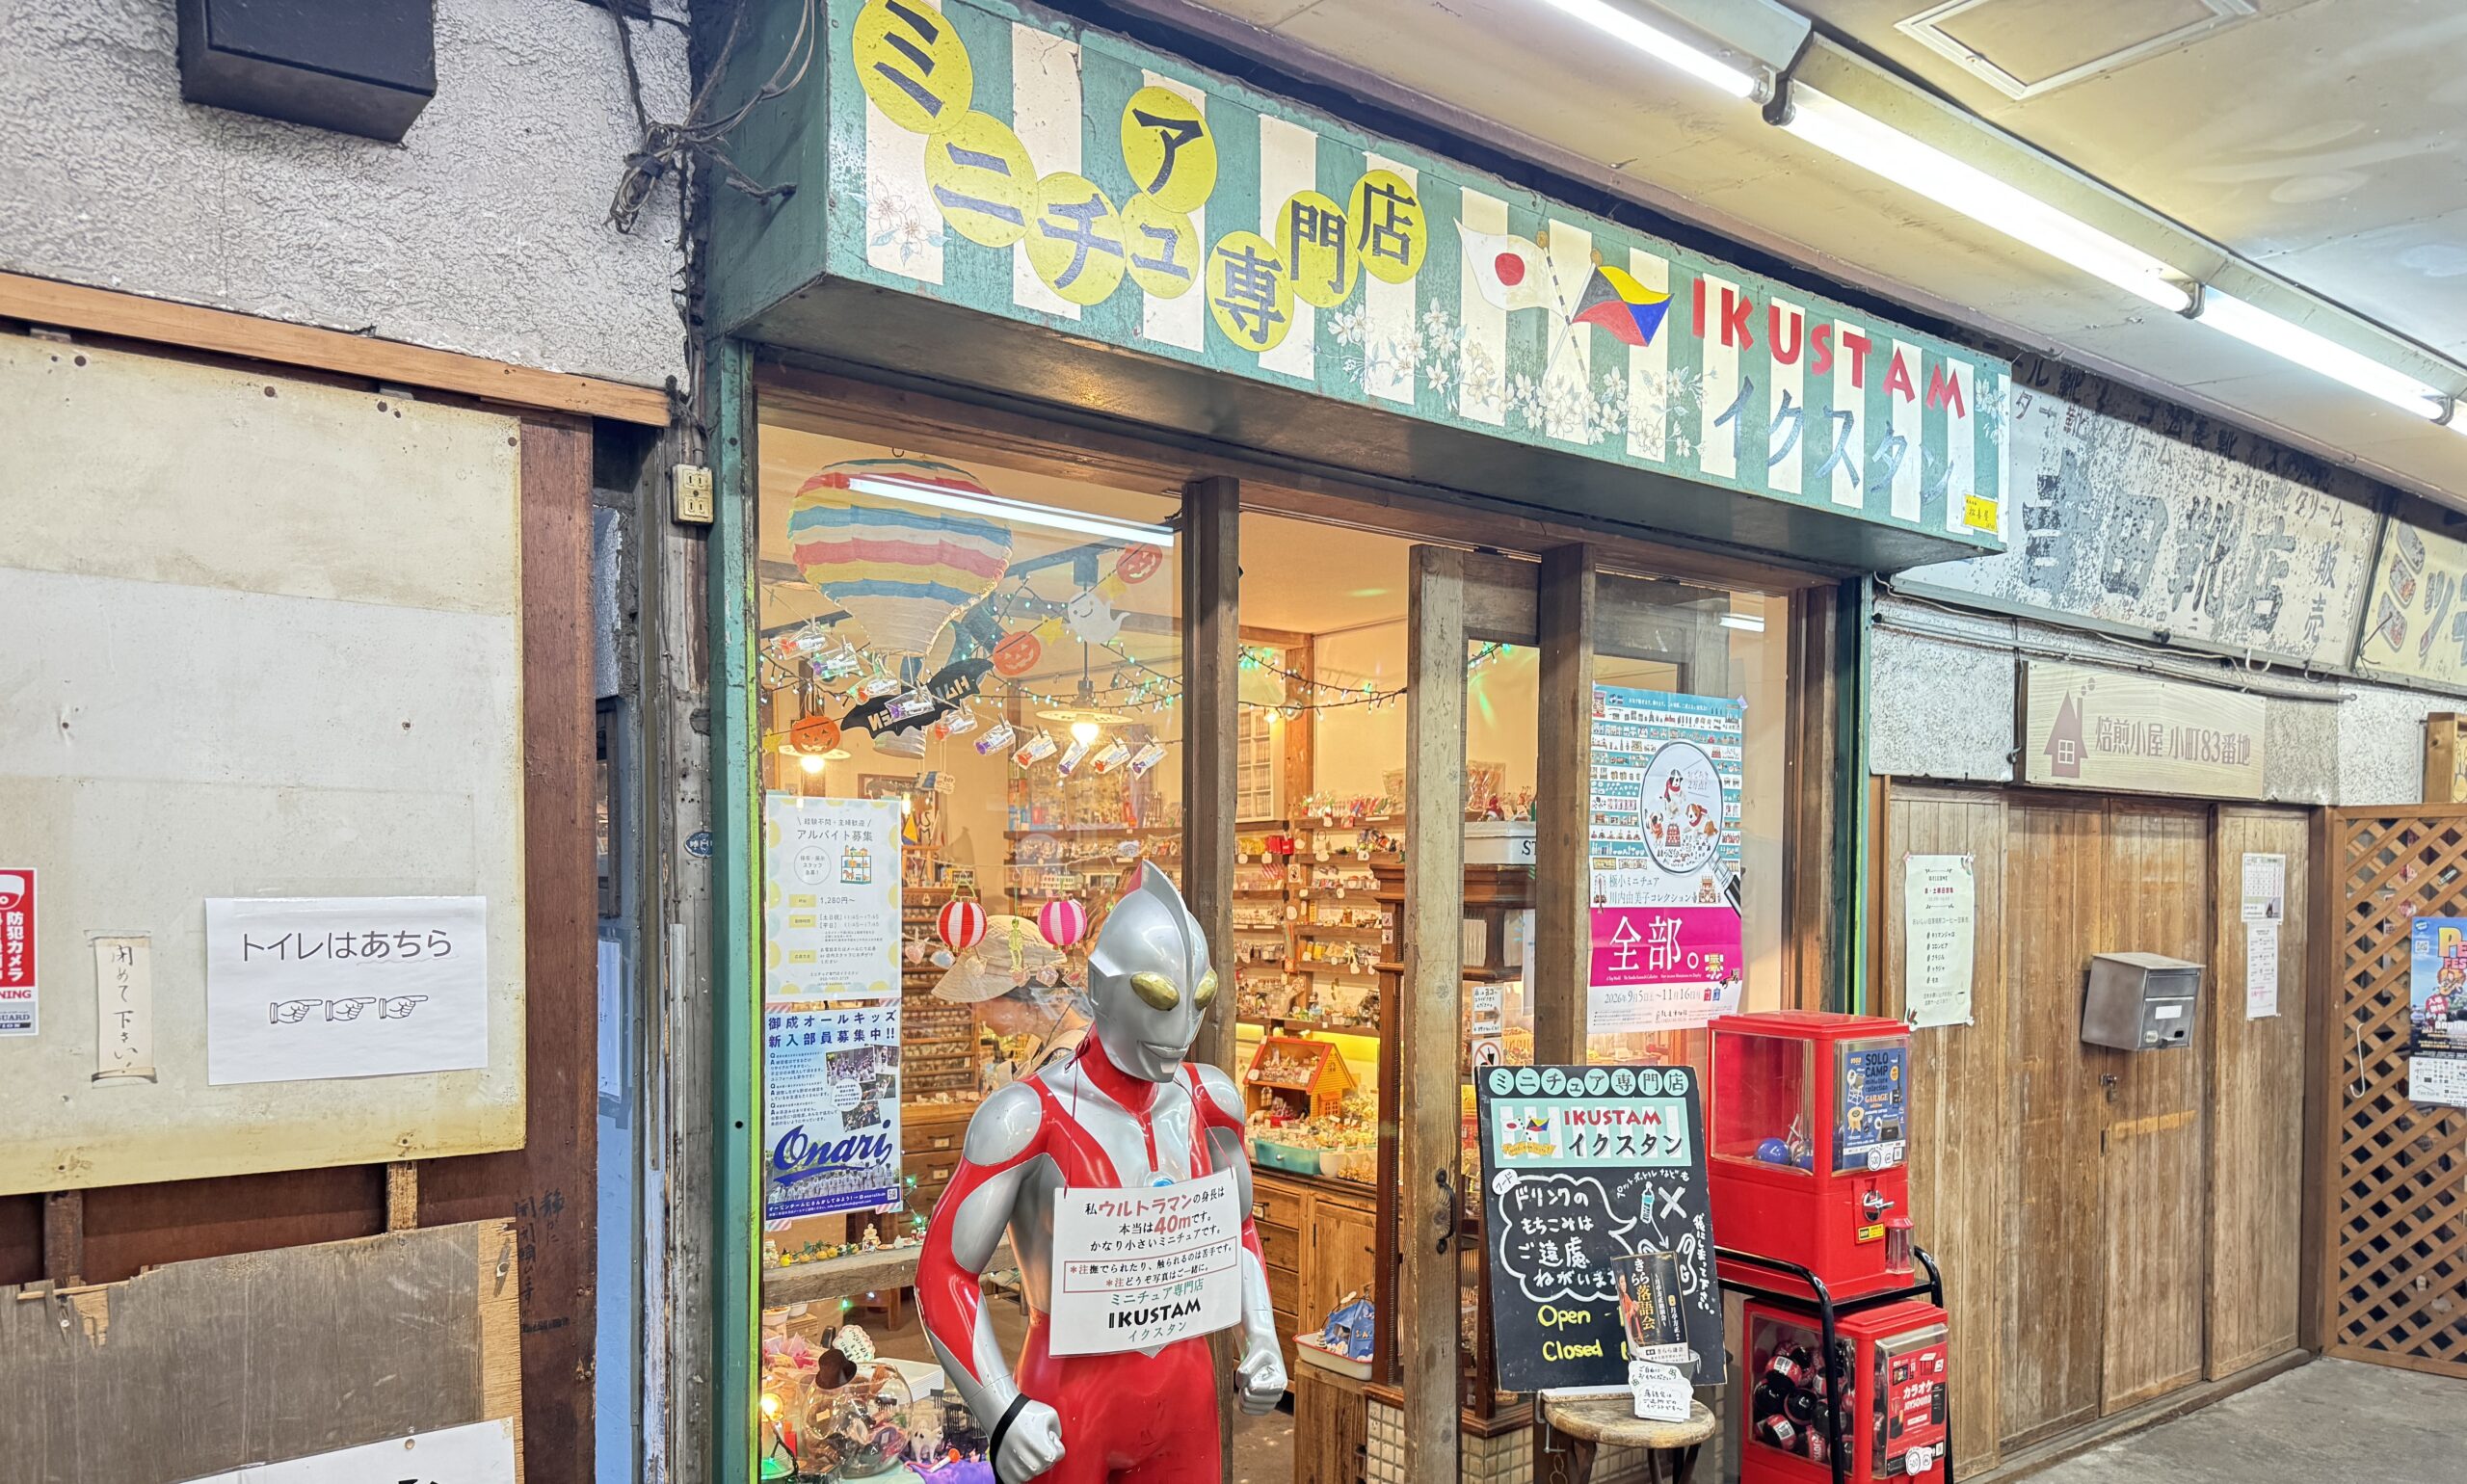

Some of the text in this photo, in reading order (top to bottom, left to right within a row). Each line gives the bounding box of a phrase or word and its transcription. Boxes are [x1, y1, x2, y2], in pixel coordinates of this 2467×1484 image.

[1693, 278, 1965, 418] IKUSTAM
[1714, 375, 1955, 506] イクスタン
[2304, 540, 2341, 643] 販売
[2096, 716, 2251, 766] 焙煎小屋 小町83番地
[797, 830, 873, 841] アルバイト募集
[1609, 874, 1659, 888] 極小ミニチュア
[1609, 891, 1693, 905] 川内由美子コレクション
[7, 911, 24, 982] 防犯カメラ
[244, 929, 452, 962] トイレはあちら
[1608, 915, 1699, 971] 全部。
[768, 1010, 896, 1030] 御成オールキッズ
[768, 1027, 894, 1048] 新入部員募集中!!
[1865, 1052, 1888, 1066] SOLO
[1494, 1073, 1685, 1094] ミニチュア専門店
[1865, 1066, 1888, 1077] CAMP
[1865, 1093, 1888, 1103] GARAGE
[1564, 1110, 1662, 1126] IKUSTAM
[774, 1120, 893, 1172] Onari
[1569, 1133, 1683, 1156] イクスタン
[1496, 1172, 1515, 1192] フード
[1084, 1186, 1225, 1217] 私ウルトラマンの身長は
[1516, 1187, 1589, 1211] ドリンクの
[1119, 1210, 1211, 1235] 本当は40mです。
[1521, 1216, 1594, 1234] もちこみは
[1090, 1225, 1221, 1252] かなり小さいミニチュアです。
[1519, 1236, 1591, 1269] ご遠慮
[1111, 1279, 1205, 1306] ミニチュア専門店
[1109, 1298, 1202, 1329] IKUSTAM
[1538, 1305, 1591, 1331] Open
[1128, 1321, 1187, 1342] イクスタン
[1543, 1338, 1604, 1362] Closed
[1903, 1380, 1934, 1400] カラオケ
